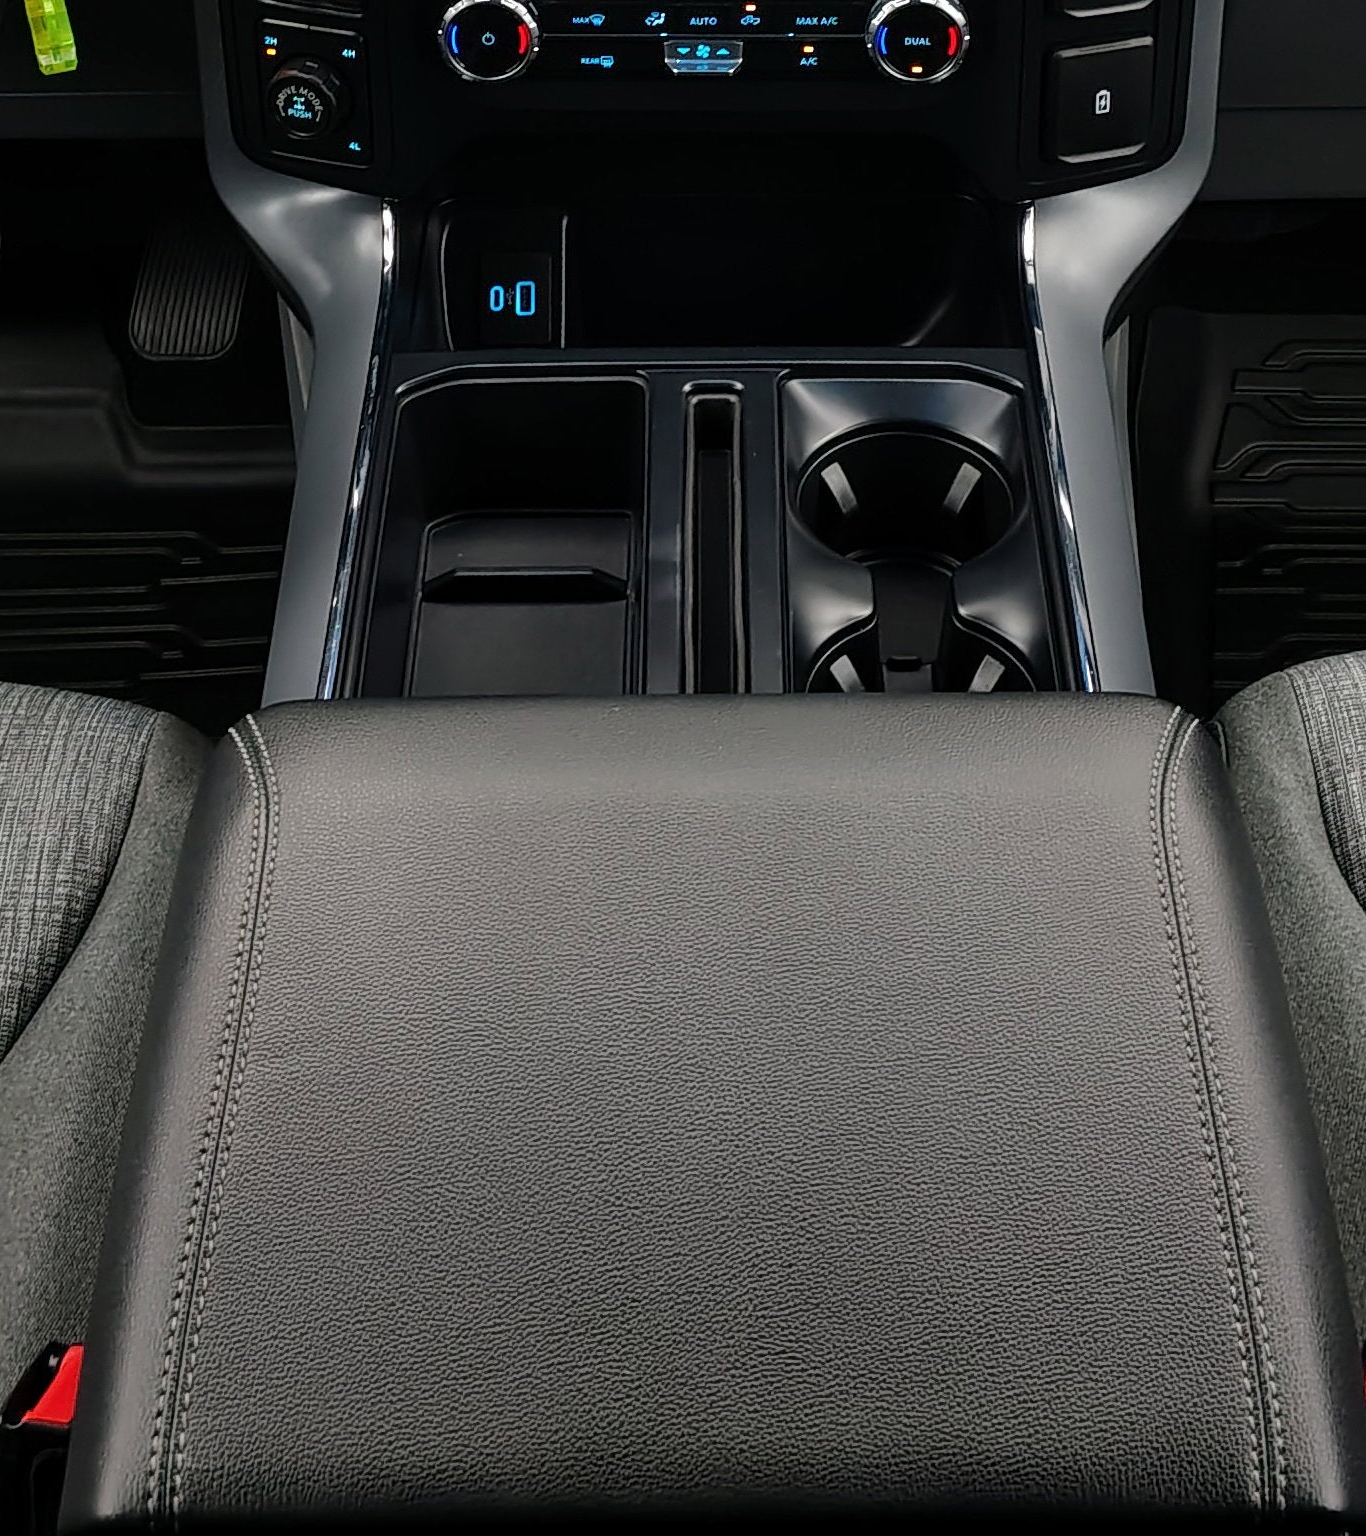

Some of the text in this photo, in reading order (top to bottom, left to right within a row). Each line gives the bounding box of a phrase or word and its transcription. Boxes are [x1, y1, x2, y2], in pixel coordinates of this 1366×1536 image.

[572, 16, 590, 25] MAX
[689, 16, 717, 26] AUTO
[796, 16, 839, 26] MAX A/C
[264, 36, 278, 46] 2H
[904, 36, 931, 46] DUAL
[342, 49, 355, 59] 4H
[800, 56, 818, 66] A/C
[276, 85, 323, 111] DRIVE MODE
[287, 108, 312, 120] PUSH
[348, 141, 361, 151] 4L
